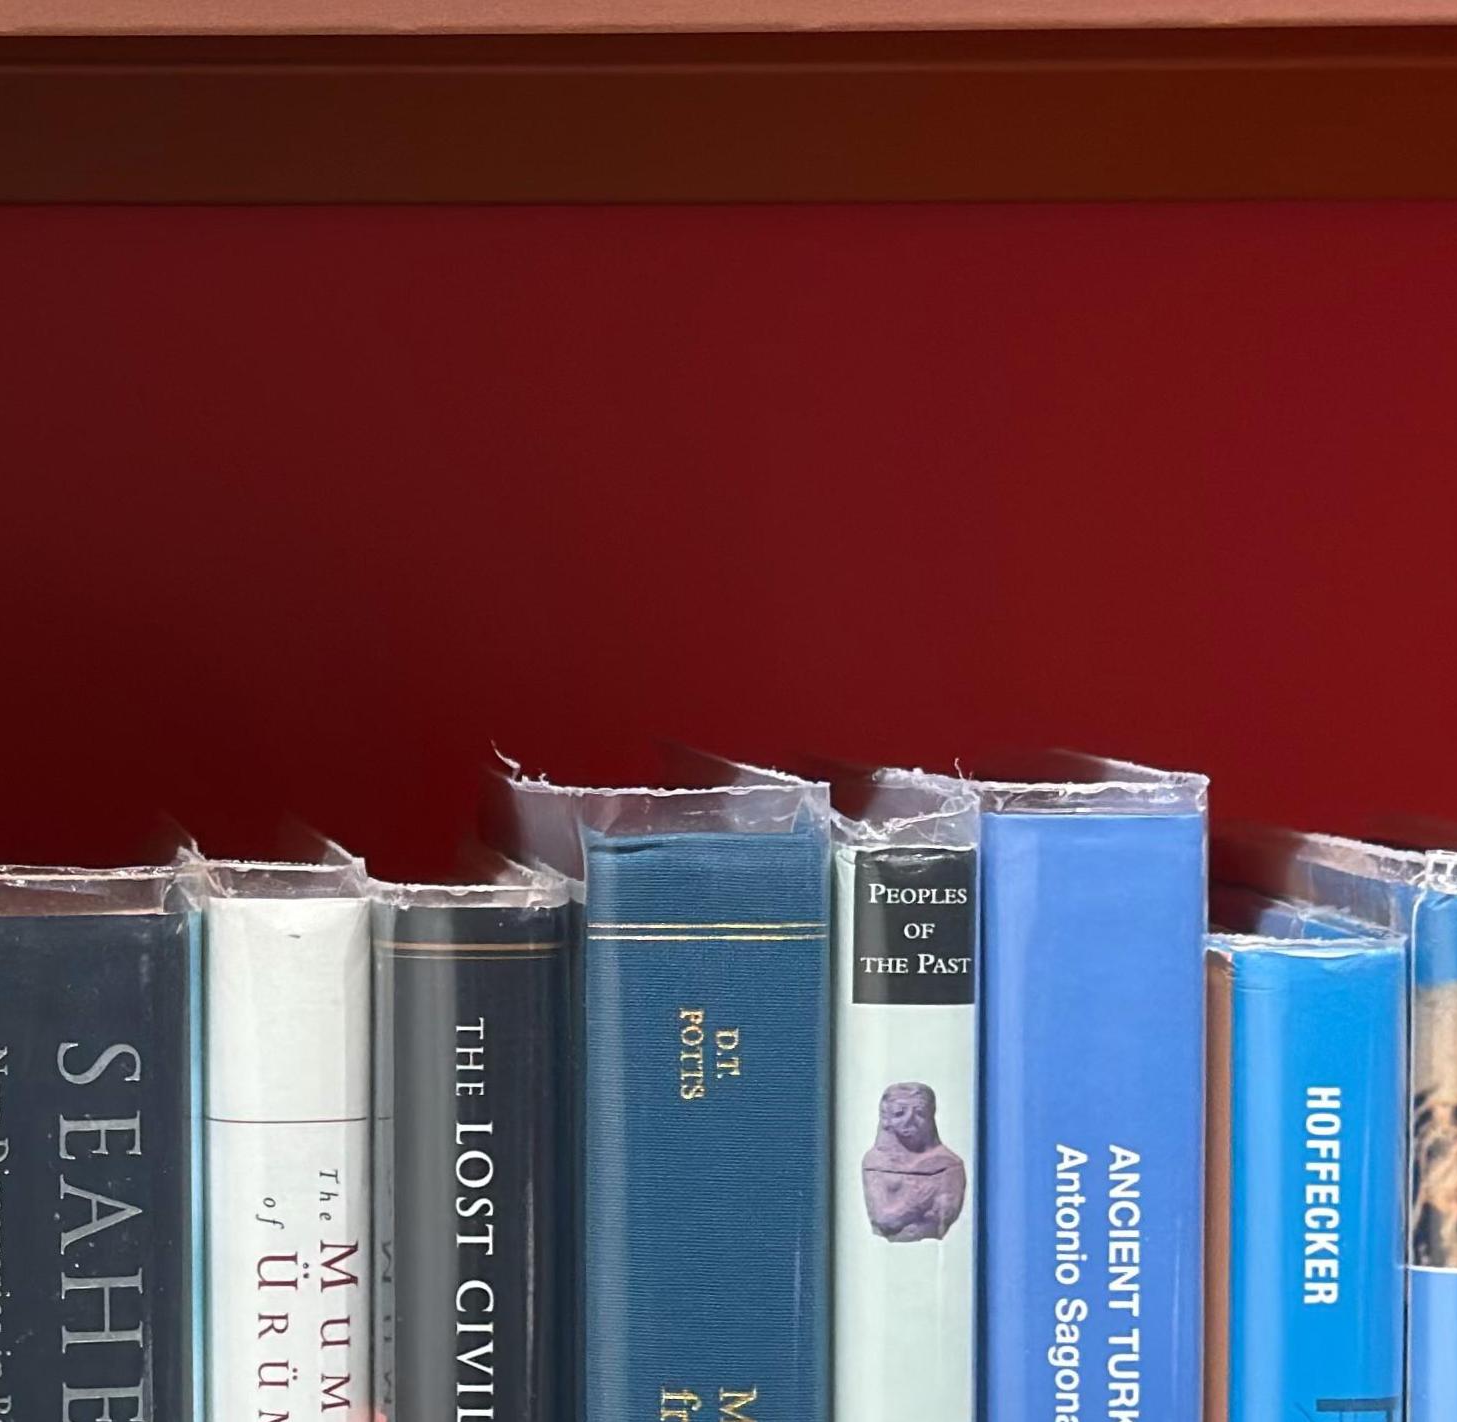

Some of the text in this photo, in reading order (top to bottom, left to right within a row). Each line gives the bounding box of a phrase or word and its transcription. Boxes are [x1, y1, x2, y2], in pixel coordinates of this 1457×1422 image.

[454, 1016, 485, 1098] THE
[678, 1006, 706, 1103] POTTS
[255, 1195, 286, 1230] of
[317, 1167, 342, 1223] The
[454, 1120, 495, 1257] LOST
[1053, 1142, 1090, 1288] Antonio
[1107, 1143, 1143, 1318] ANCIENT
[1302, 1085, 1342, 1306] HOFFECKER
